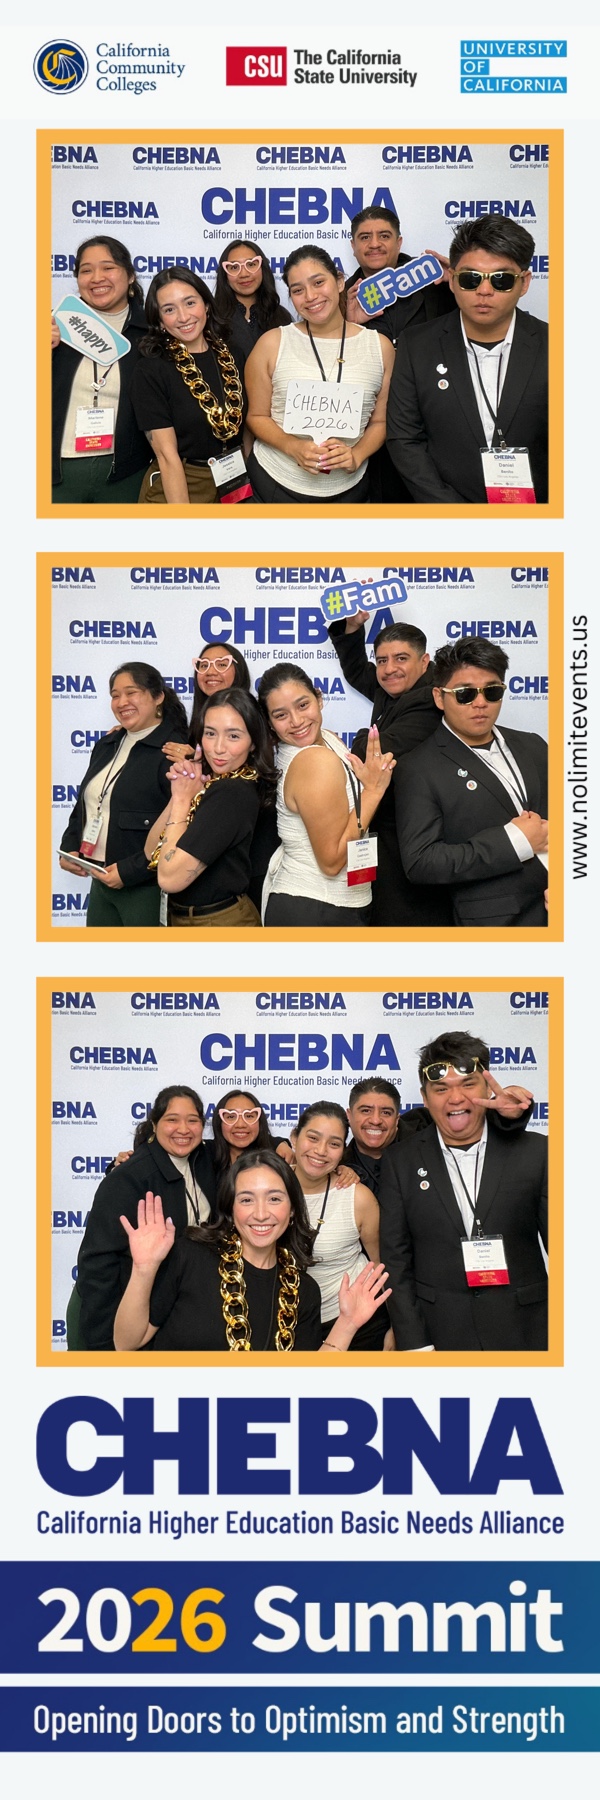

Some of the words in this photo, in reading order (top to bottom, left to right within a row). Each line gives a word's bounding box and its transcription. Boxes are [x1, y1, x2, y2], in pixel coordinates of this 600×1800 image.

[133, 147, 221, 164] CHEBNA
[256, 147, 346, 164] CHEBNA
[382, 146, 473, 163] CHEBNA
[72, 200, 159, 218] CHEBNA
[445, 200, 536, 218] CHEBNA
[203, 229, 242, 239] California
[245, 229, 271, 241] Higher
[274, 229, 314, 239] Education
[317, 229, 338, 239] Basic
[362, 260, 437, 309] #Fam
[69, 316, 112, 353] #happy
[293, 394, 352, 413] CHEBNA
[302, 416, 347, 429] 2026
[130, 567, 219, 584] CHEBNA
[256, 567, 346, 583] CHEBNA
[326, 582, 402, 615] #Fam
[69, 620, 156, 638] CHEBNA
[446, 621, 537, 638] CHEBNA
[244, 650, 271, 660] Higher
[273, 650, 314, 659] Education
[131, 992, 220, 1010] CHEBNA
[256, 993, 346, 1009] CHEBNA
[382, 992, 473, 1009] CHEBNA
[70, 1046, 157, 1064] CHEBNA
[200, 1033, 401, 1071] CHEBNA
[202, 1076, 242, 1085] California
[244, 1076, 271, 1087] Higher
[274, 1076, 314, 1085] Education
[317, 1076, 339, 1085] Basic
